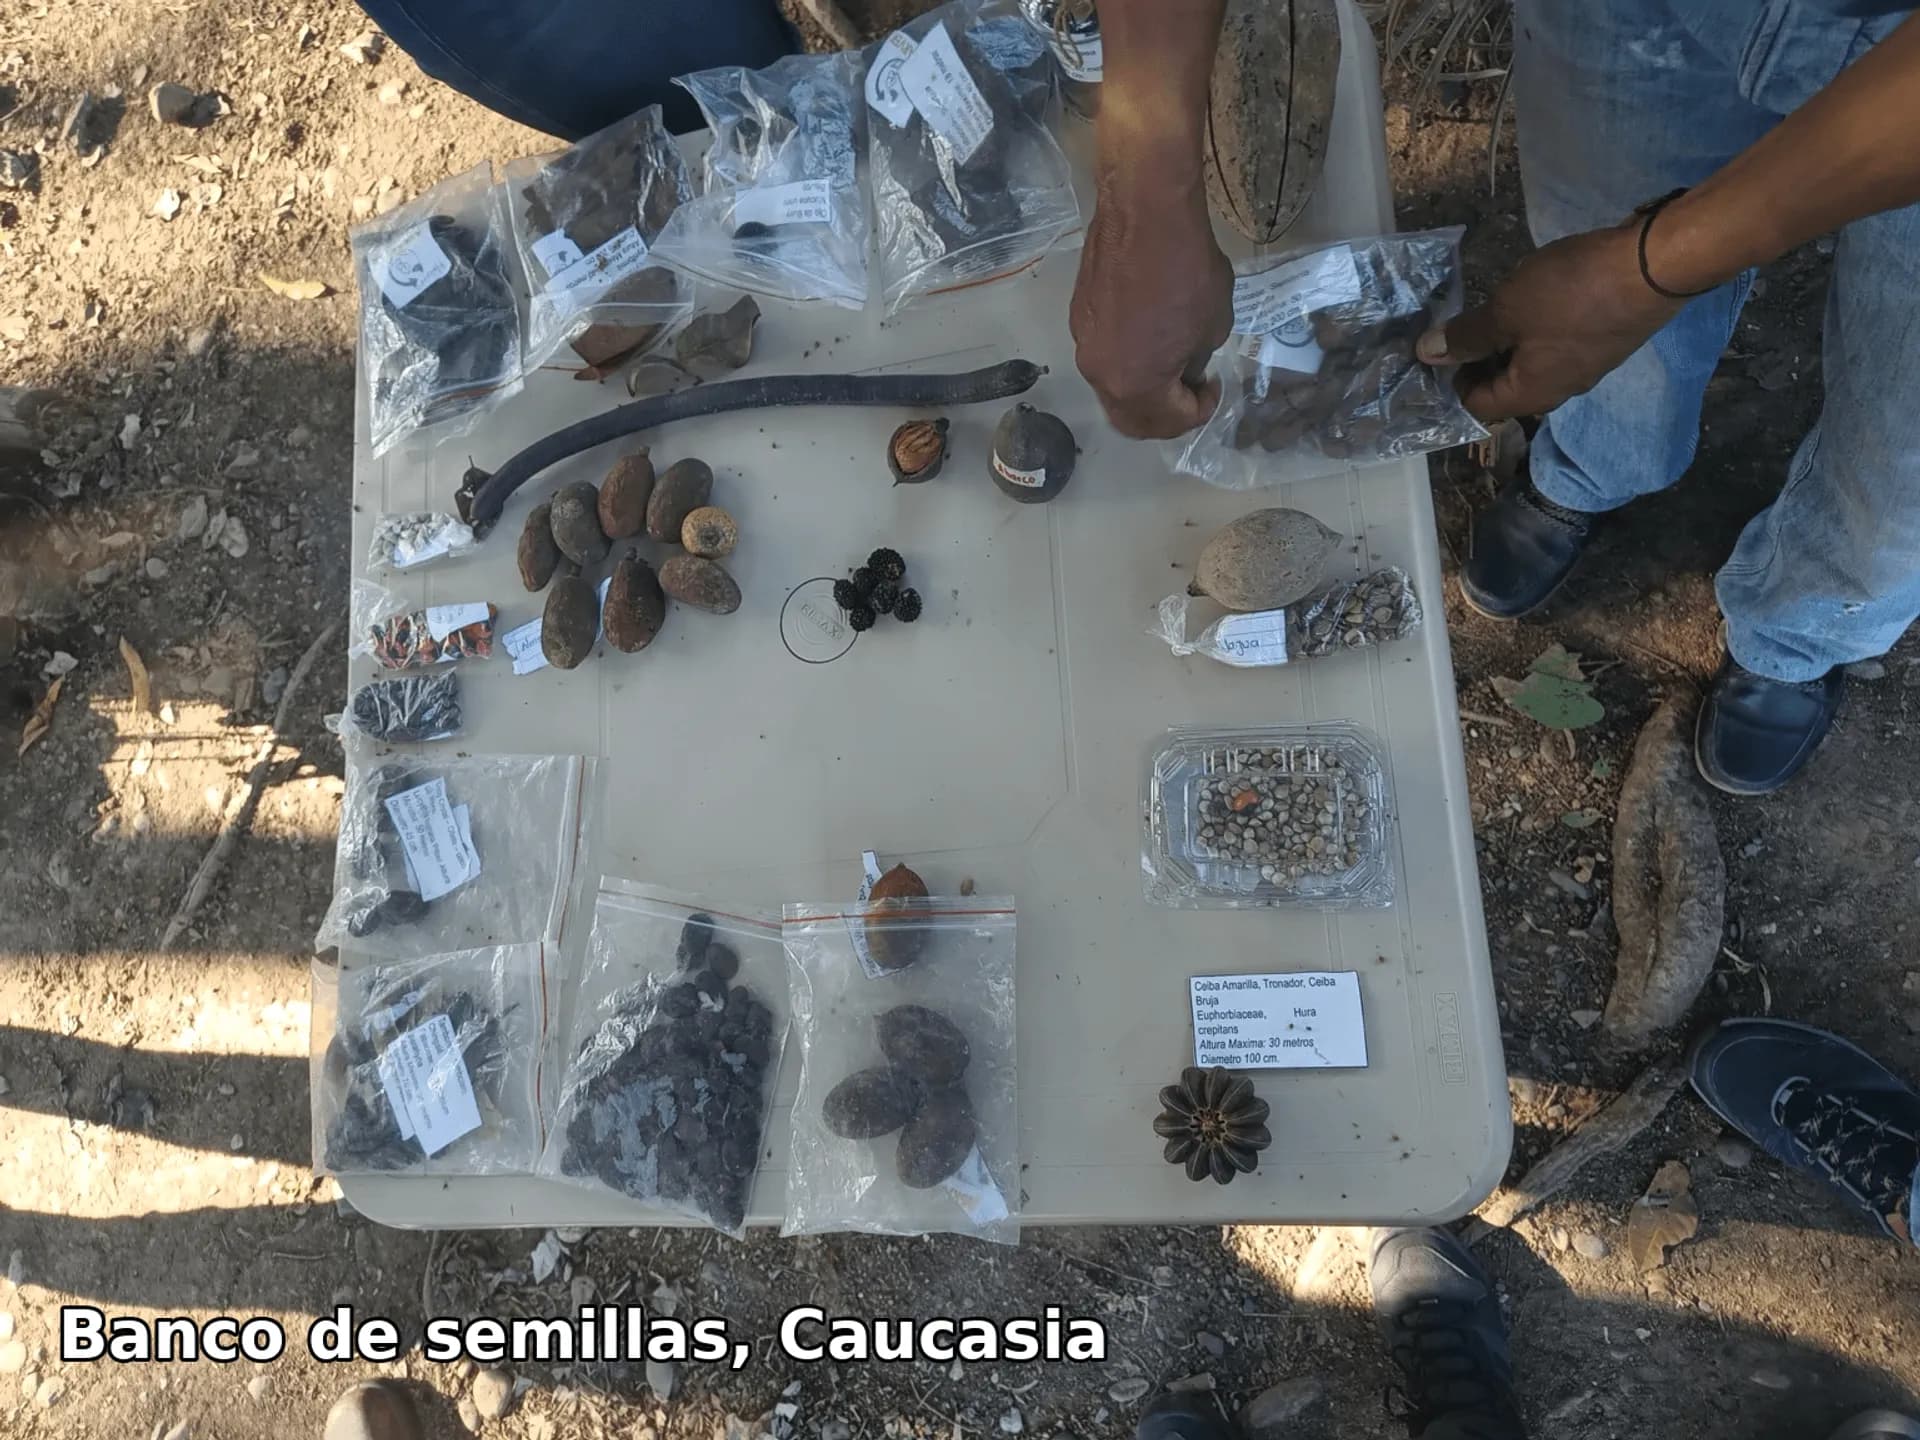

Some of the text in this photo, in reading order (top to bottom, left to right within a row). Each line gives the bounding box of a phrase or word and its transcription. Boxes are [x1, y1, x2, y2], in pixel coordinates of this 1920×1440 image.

[1195, 980, 1220, 991] Ceiba
[1222, 979, 1261, 991] Amarilla,
[1308, 976, 1336, 988] Ceiba
[1195, 996, 1219, 1008] Bruja
[1197, 1007, 1317, 1021] Euphorbiaceae, Hura
[1198, 1025, 1239, 1036] crepitans
[1200, 1039, 1226, 1049] Altura
[1269, 1038, 1280, 1048] 30
[1282, 1038, 1314, 1048] metros
[1245, 1053, 1261, 1064] 100
[1263, 1055, 1280, 1064] cm.
